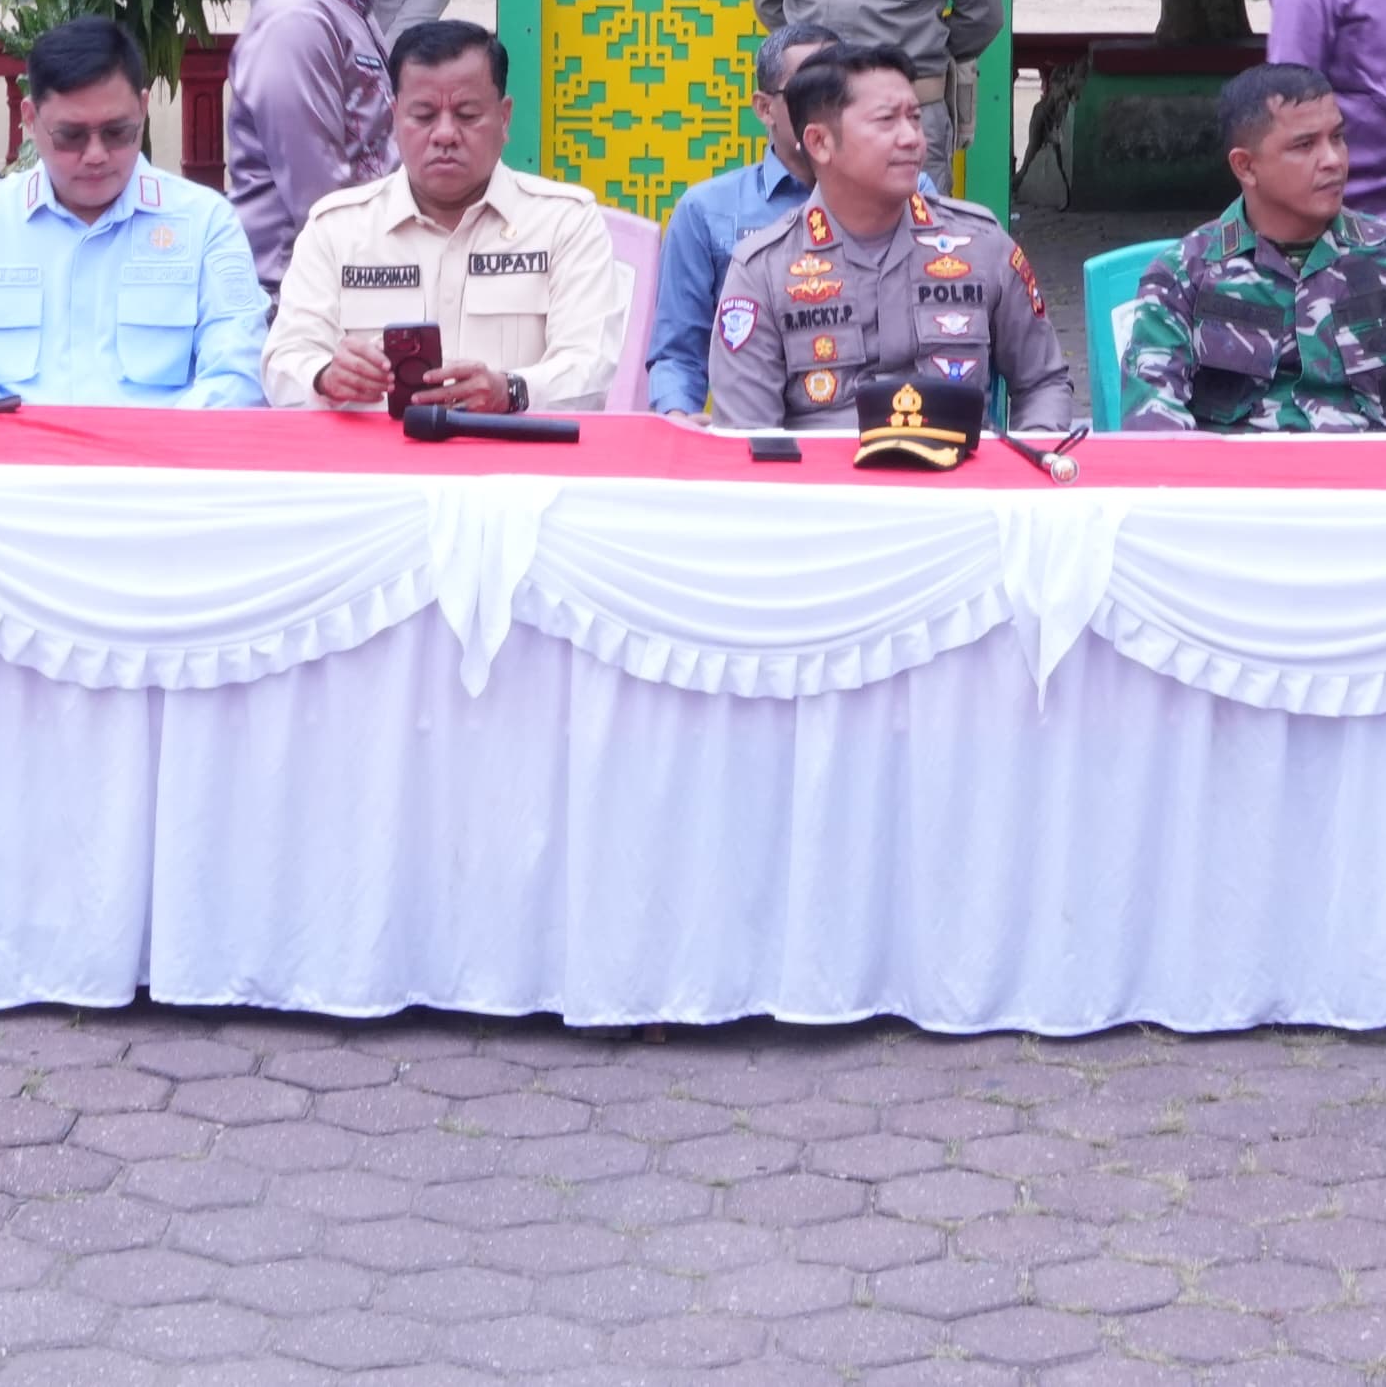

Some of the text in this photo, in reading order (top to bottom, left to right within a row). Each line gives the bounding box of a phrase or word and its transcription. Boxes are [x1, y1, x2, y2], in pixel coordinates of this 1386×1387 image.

[473, 254, 544, 272] BUPATI
[344, 267, 417, 287] SUHARDIMAN
[918, 284, 984, 303] POLRI
